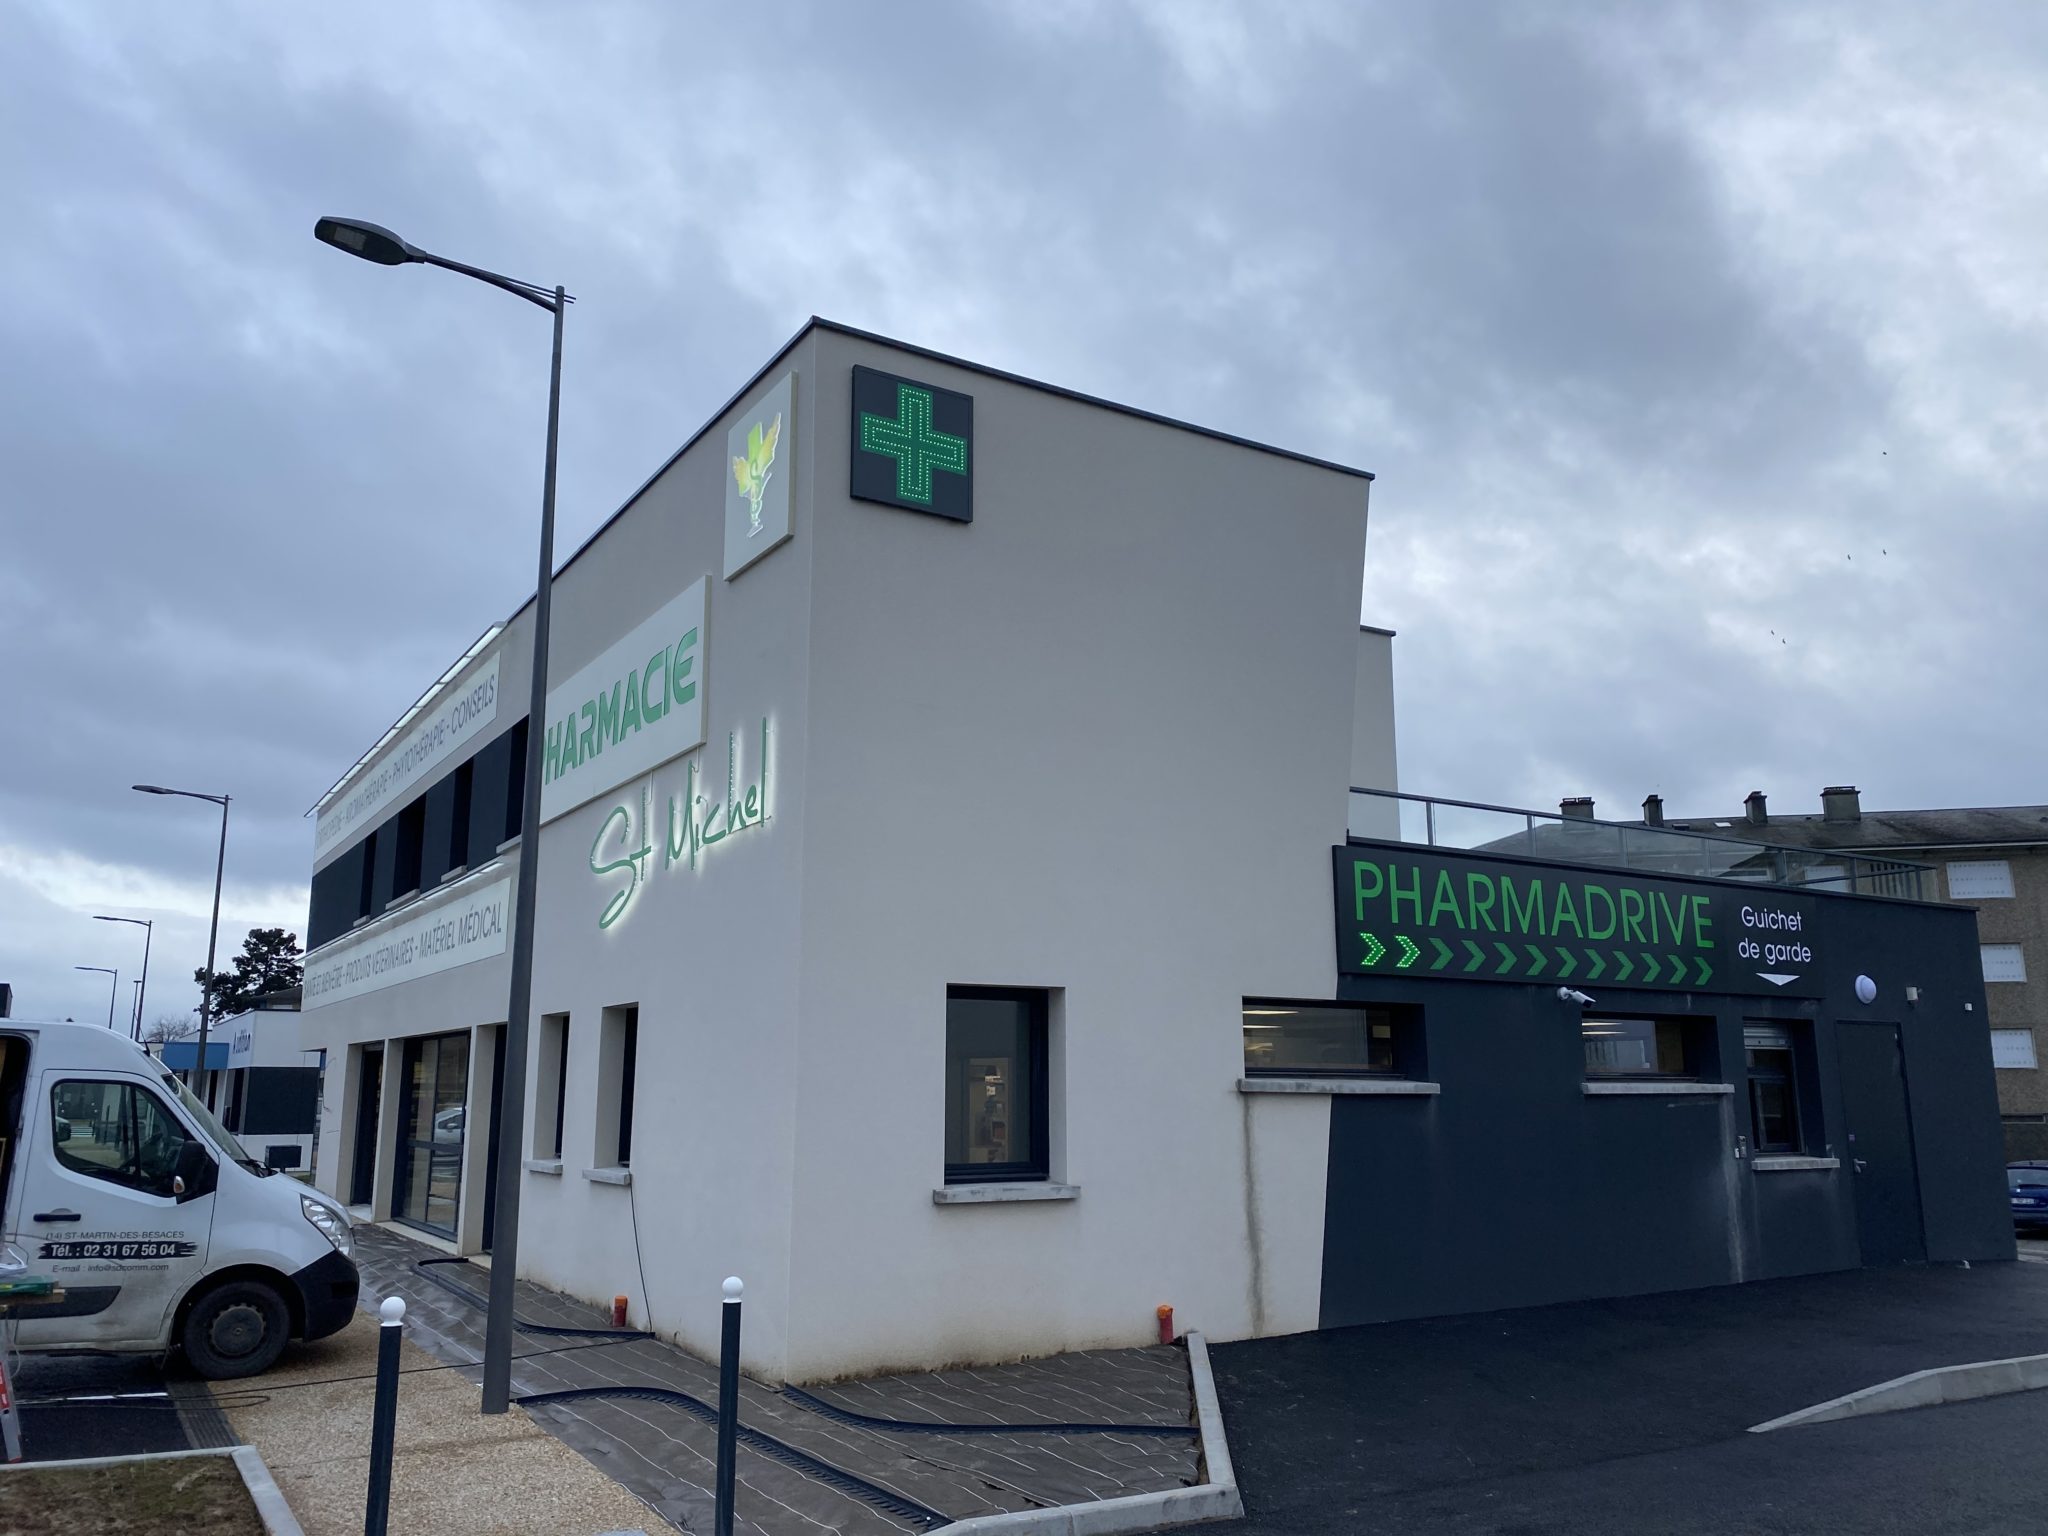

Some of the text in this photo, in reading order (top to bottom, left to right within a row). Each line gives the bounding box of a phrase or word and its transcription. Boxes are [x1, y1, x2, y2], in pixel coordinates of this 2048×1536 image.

[393, 719, 444, 784] PHYTOTHÉRAPIE
[451, 674, 495, 735] CONSEILS
[541, 627, 697, 785] HARMACIE
[590, 716, 768, 929] St Michel
[1353, 860, 1716, 949] PHARMADRIVE
[1741, 906, 1803, 932] Guichet
[372, 936, 414, 975] VÉTÉRINAIRES
[419, 918, 456, 959] MATÉRIEL
[458, 901, 502, 946] MÉDICAL
[1738, 938, 1812, 964] de garde
[46, 1231, 185, 1241] (14) ST-MARTIN-DES-BESACES
[51, 1244, 73, 1257] Tél.
[83, 1245, 100, 1257] 02
[103, 1245, 118, 1256] 31
[122, 1244, 138, 1256] 67
[141, 1244, 157, 1256] 56
[160, 1244, 176, 1255] 04
[52, 1265, 81, 1273] E-mail
